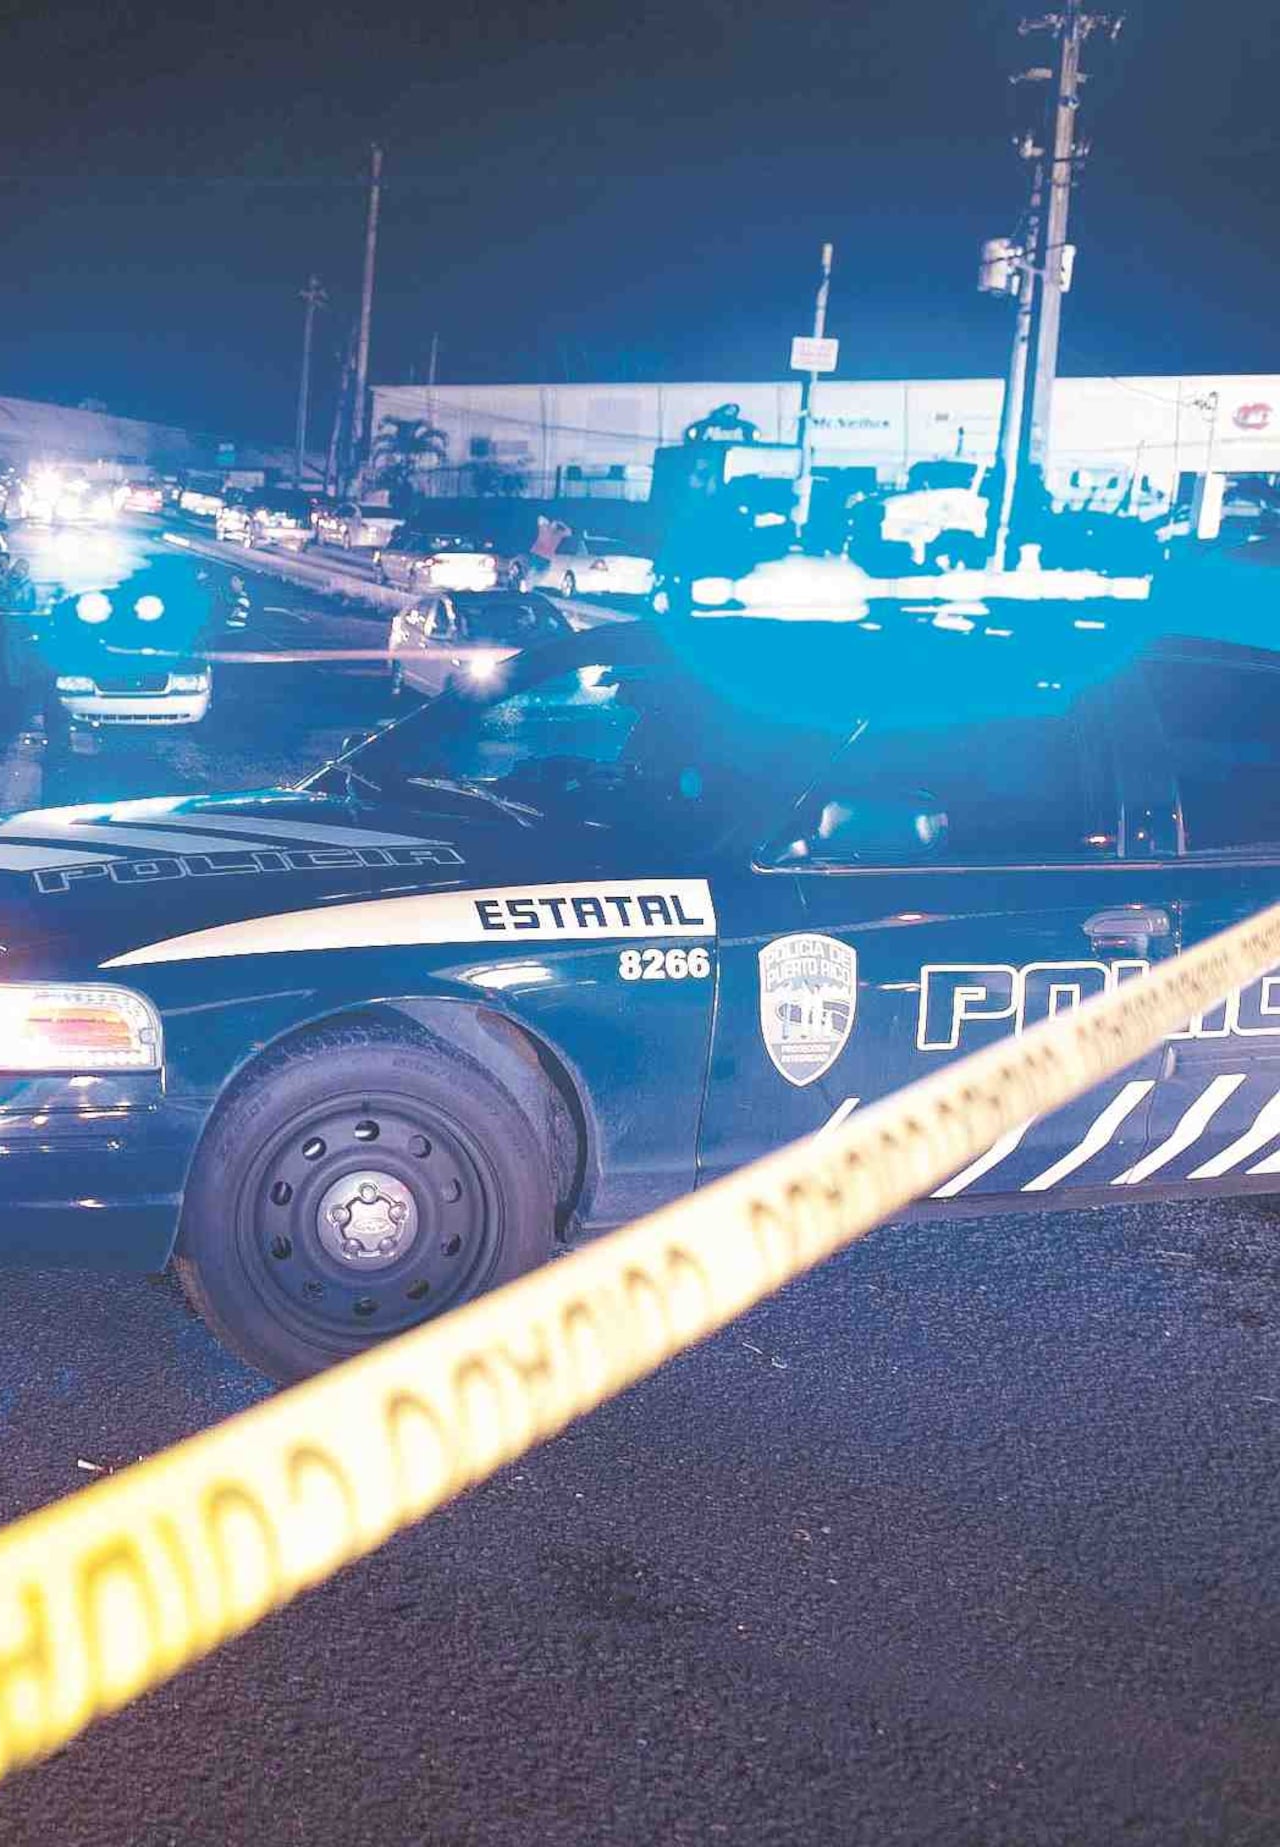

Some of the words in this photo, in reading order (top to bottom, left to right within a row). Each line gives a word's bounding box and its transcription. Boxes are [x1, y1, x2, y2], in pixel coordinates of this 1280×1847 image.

[33, 846, 466, 894] POLICIA
[474, 895, 705, 931] ESTATAL
[619, 947, 711, 981] 8266
[765, 940, 825, 969] POLICIA
[829, 944, 851, 970] DE
[767, 957, 818, 990] PUERTO
[821, 959, 851, 987] RICO
